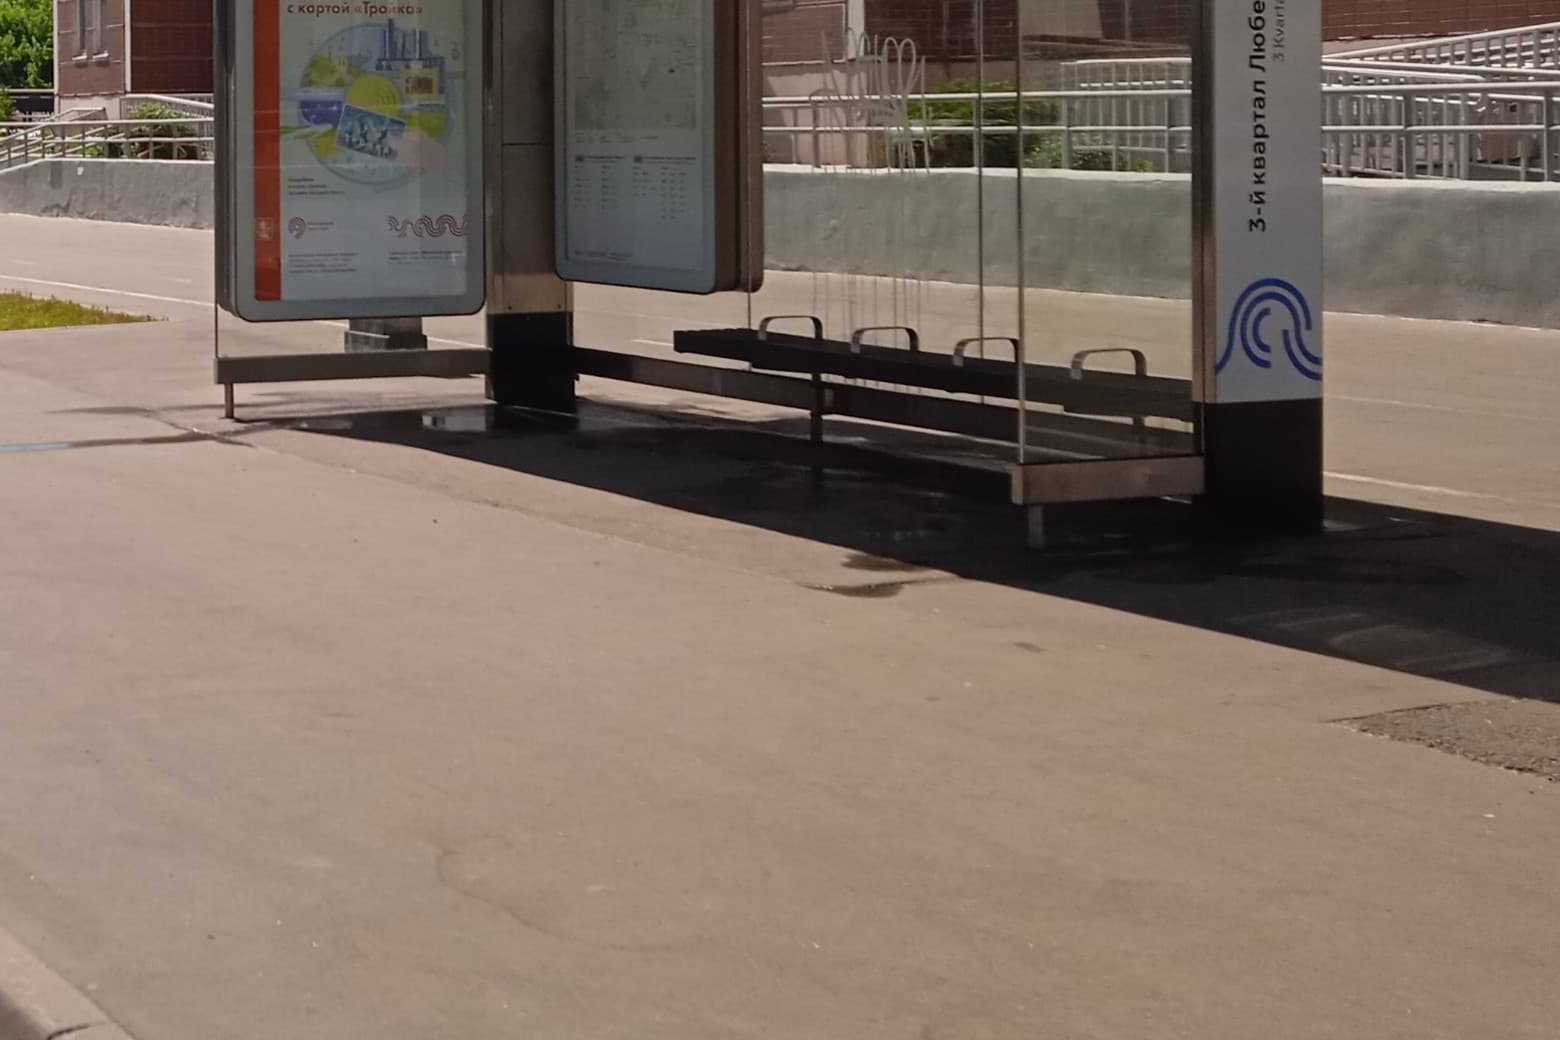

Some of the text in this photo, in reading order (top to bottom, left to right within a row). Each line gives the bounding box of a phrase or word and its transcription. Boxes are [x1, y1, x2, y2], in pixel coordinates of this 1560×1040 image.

[287, 5, 295, 14] с
[297, 2, 350, 17] картой
[1273, 53, 1285, 63] 3
[1252, 80, 1269, 185] квартал
[1248, 190, 1266, 233] 3-й
